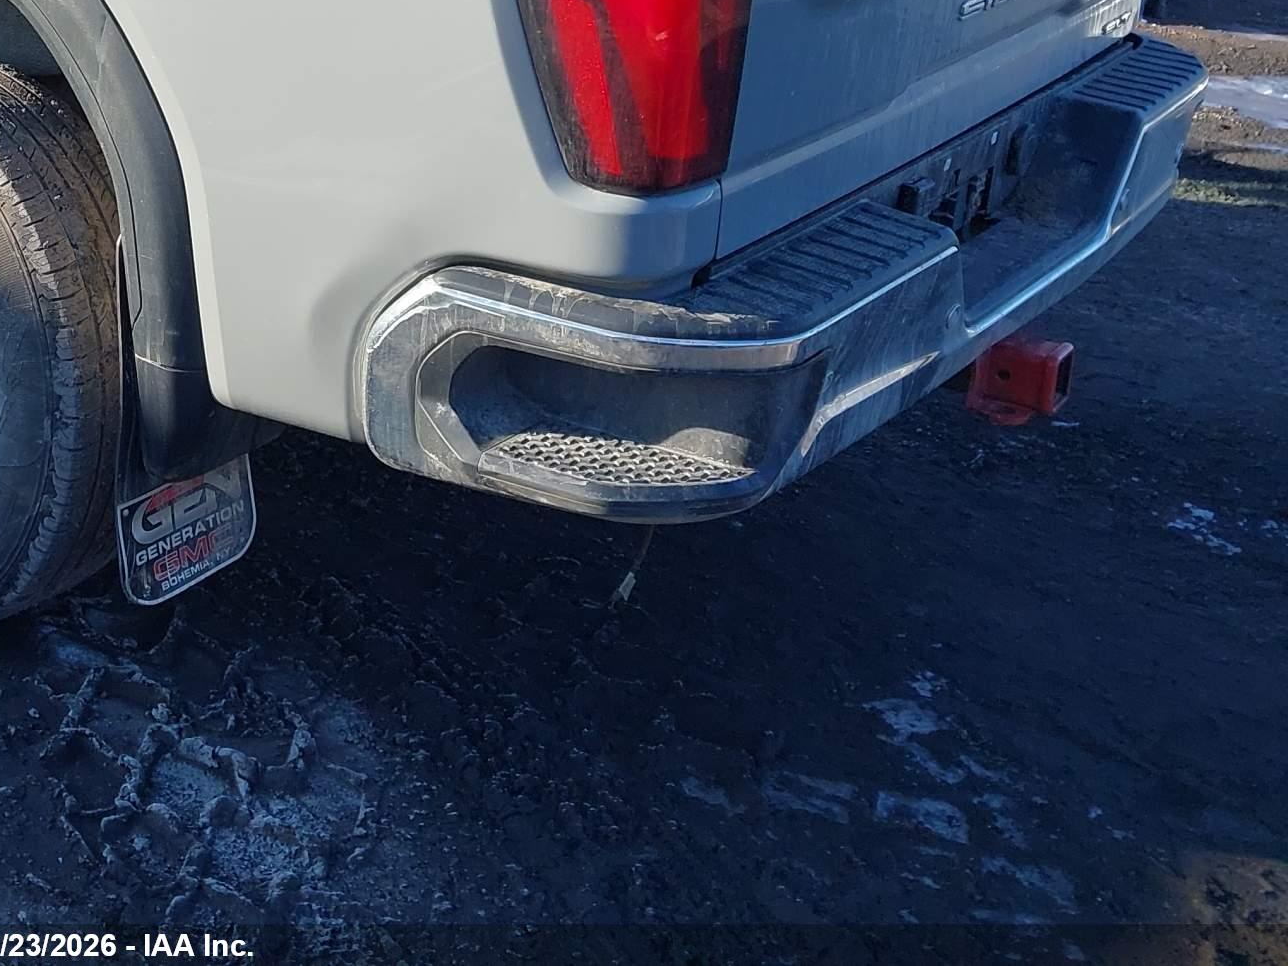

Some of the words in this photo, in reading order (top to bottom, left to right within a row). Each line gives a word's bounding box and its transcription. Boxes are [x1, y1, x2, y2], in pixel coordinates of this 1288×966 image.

[1101, 10, 1132, 35] SLT
[135, 499, 245, 567] GENERATION
[153, 524, 233, 582] GMC
